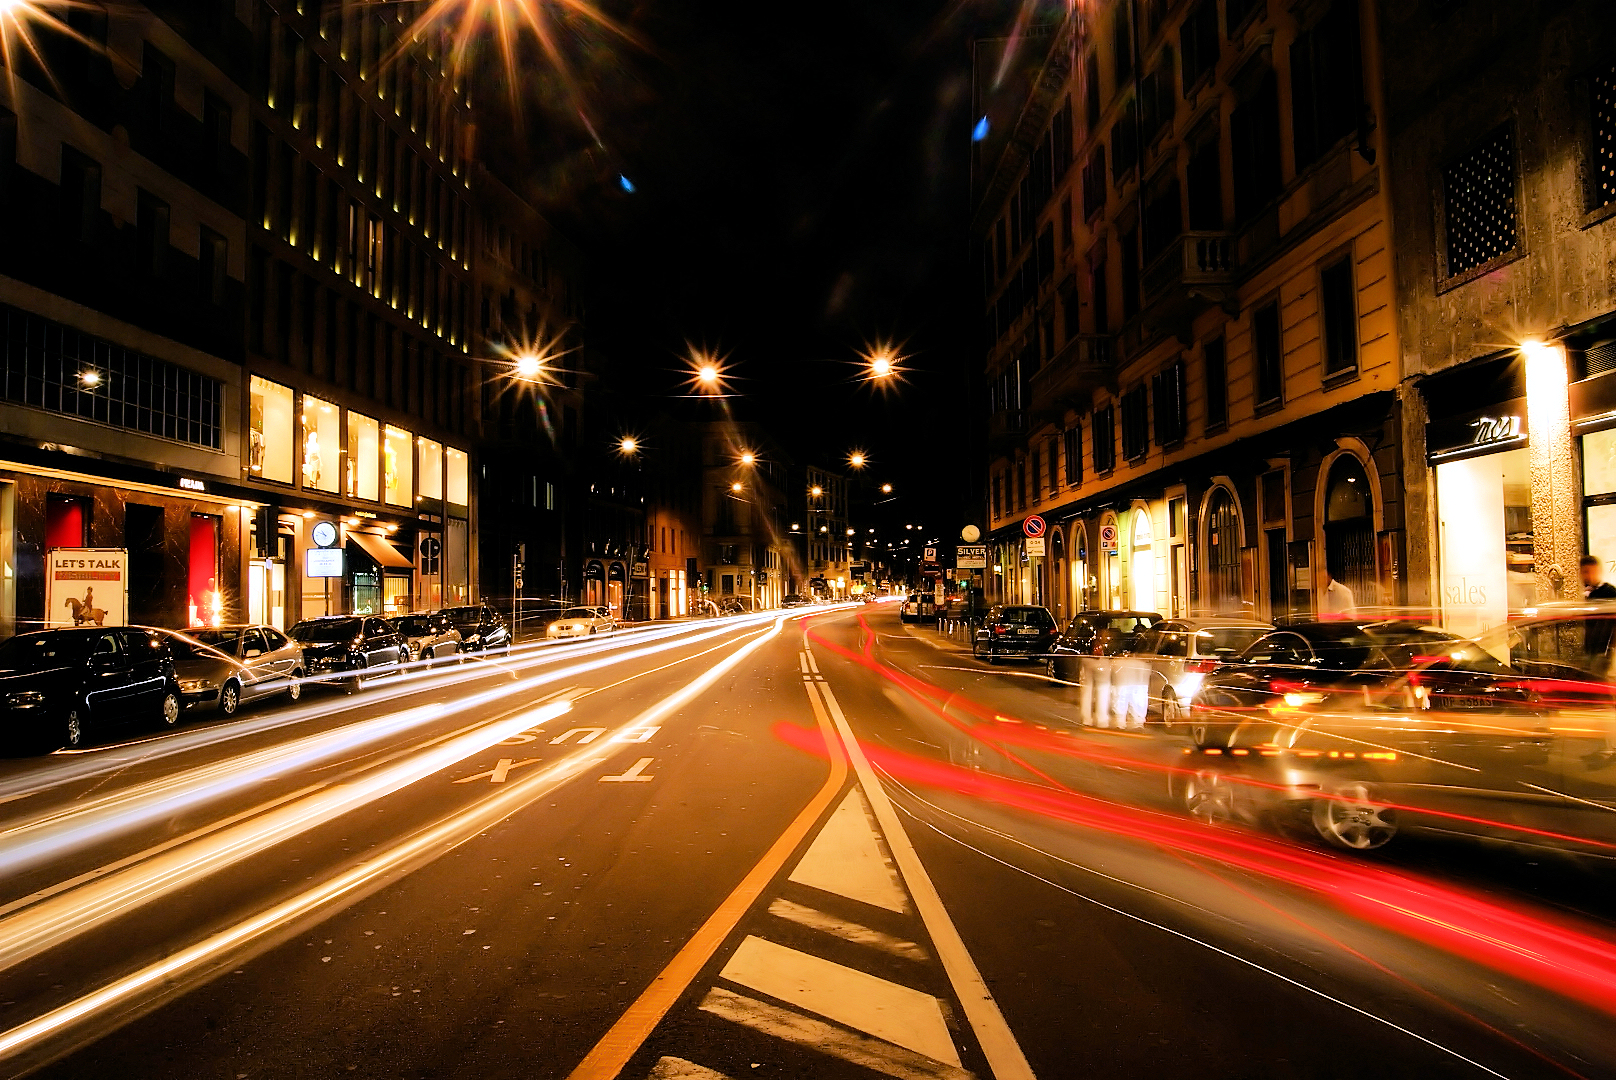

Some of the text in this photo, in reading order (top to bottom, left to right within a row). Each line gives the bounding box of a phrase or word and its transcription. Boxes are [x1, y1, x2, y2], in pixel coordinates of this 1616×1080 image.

[55, 559, 120, 569] LET'S TALK
[1445, 576, 1487, 605] sales
[499, 726, 662, 746] BUS
